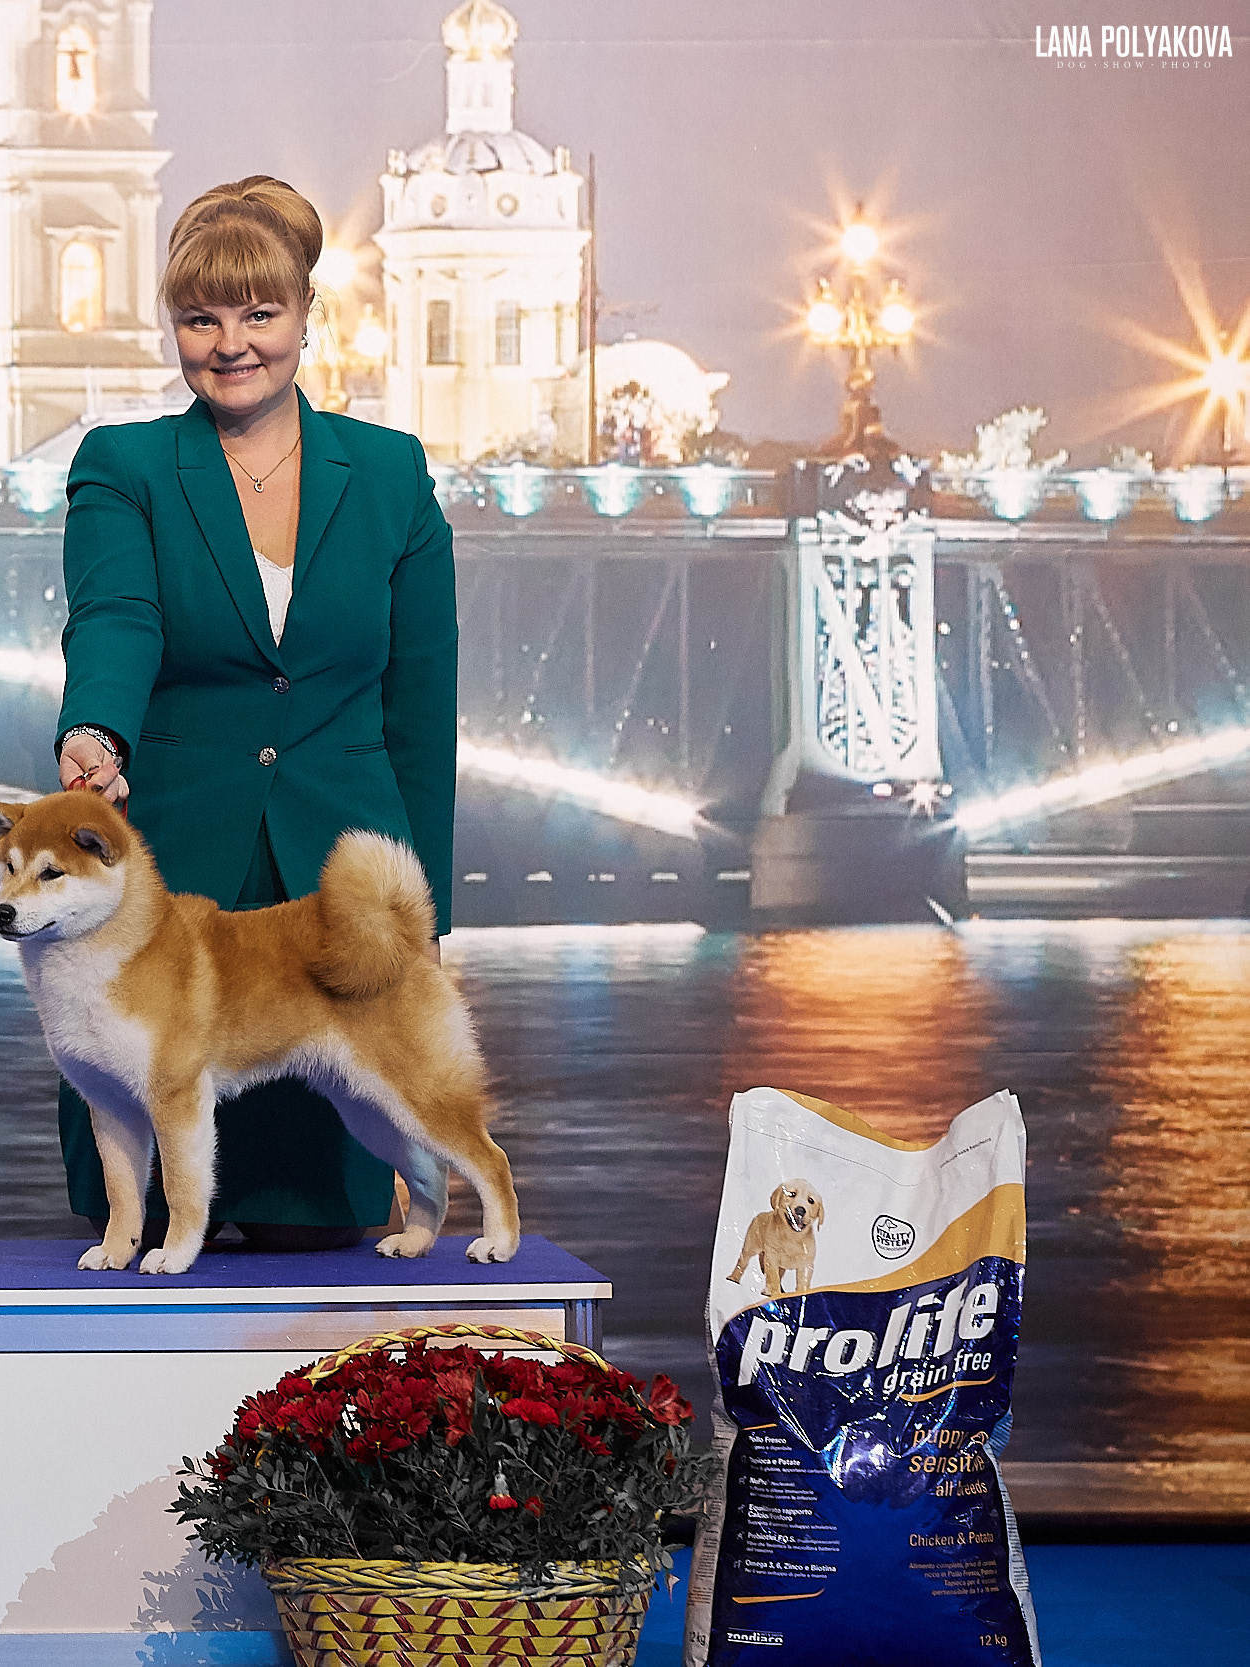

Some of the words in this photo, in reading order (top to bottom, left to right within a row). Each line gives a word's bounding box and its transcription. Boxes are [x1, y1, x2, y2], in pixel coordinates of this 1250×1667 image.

[876, 1226, 911, 1240] VITALITY
[876, 1235, 910, 1246] SYSTEM
[737, 1277, 1000, 1387] prolife
[883, 1363, 948, 1395] grain
[953, 1349, 992, 1373] free
[910, 1533, 954, 1547] Chicken
[956, 1532, 966, 1545] &
[979, 1635, 992, 1646] 12
[994, 1634, 1008, 1647] kg
